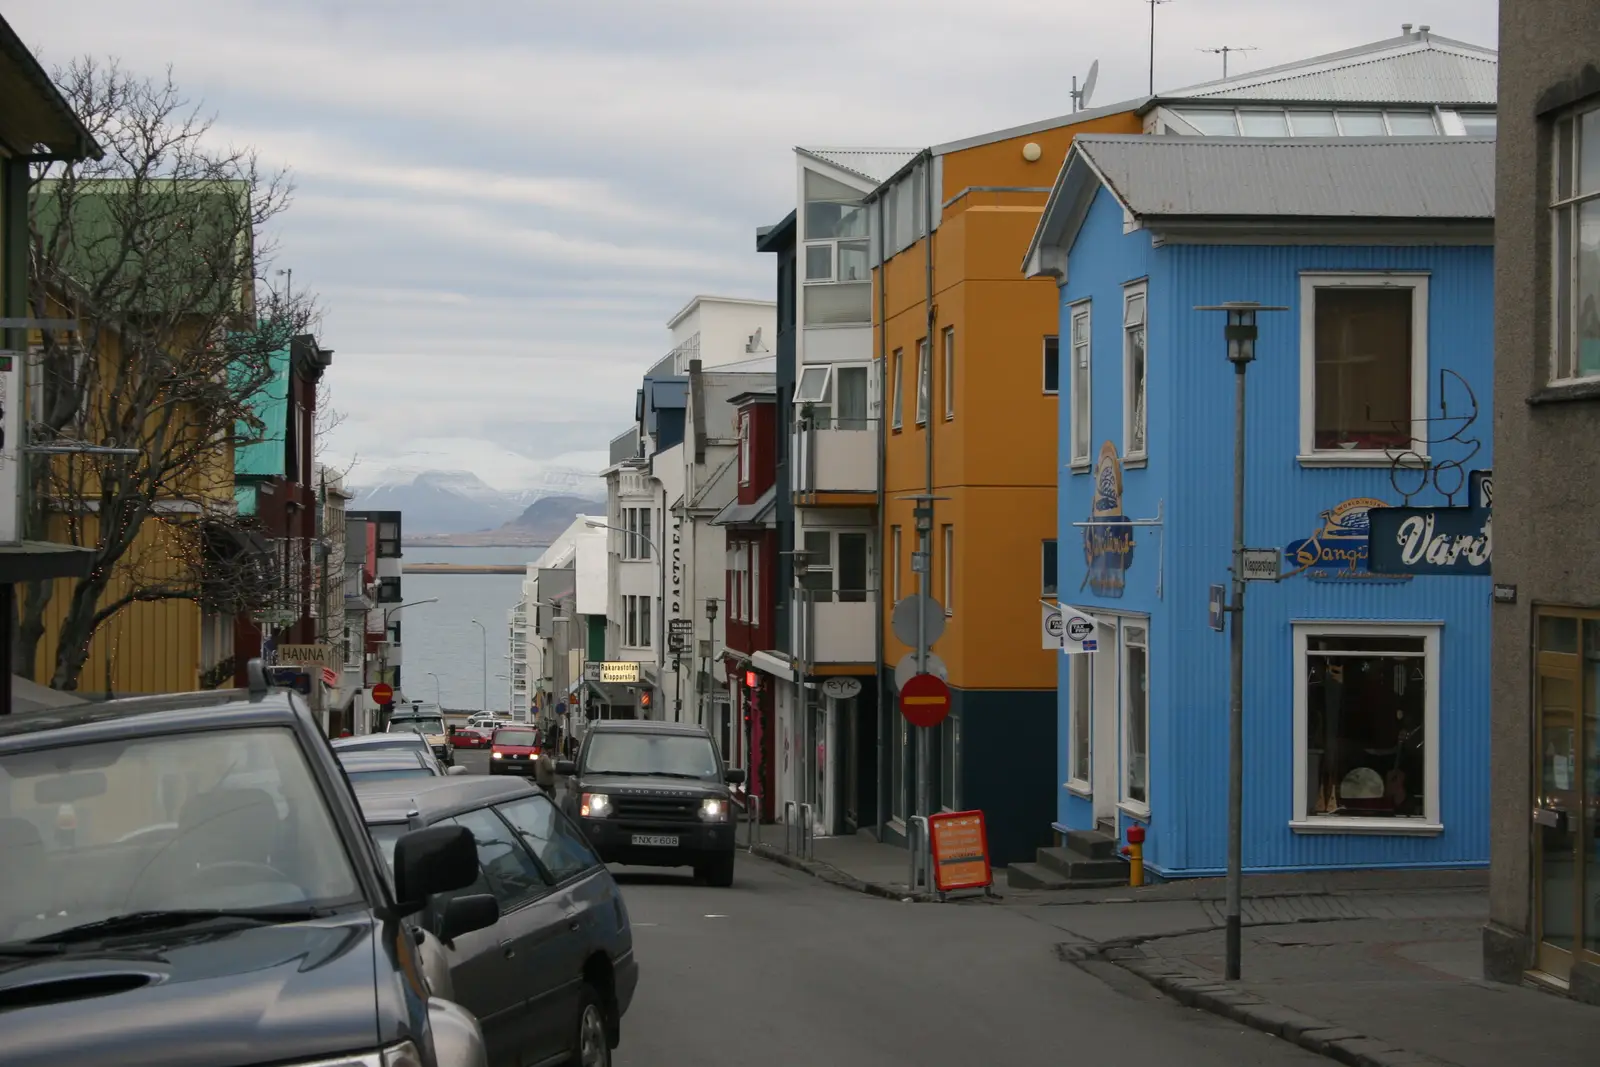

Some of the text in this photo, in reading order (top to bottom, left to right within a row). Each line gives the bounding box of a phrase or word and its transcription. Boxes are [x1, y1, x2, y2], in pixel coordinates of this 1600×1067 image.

[1337, 499, 1360, 511] WORLD
[282, 648, 324, 661] HANNA
[600, 663, 639, 671] Rakarastofan
[826, 680, 858, 693] RYK
